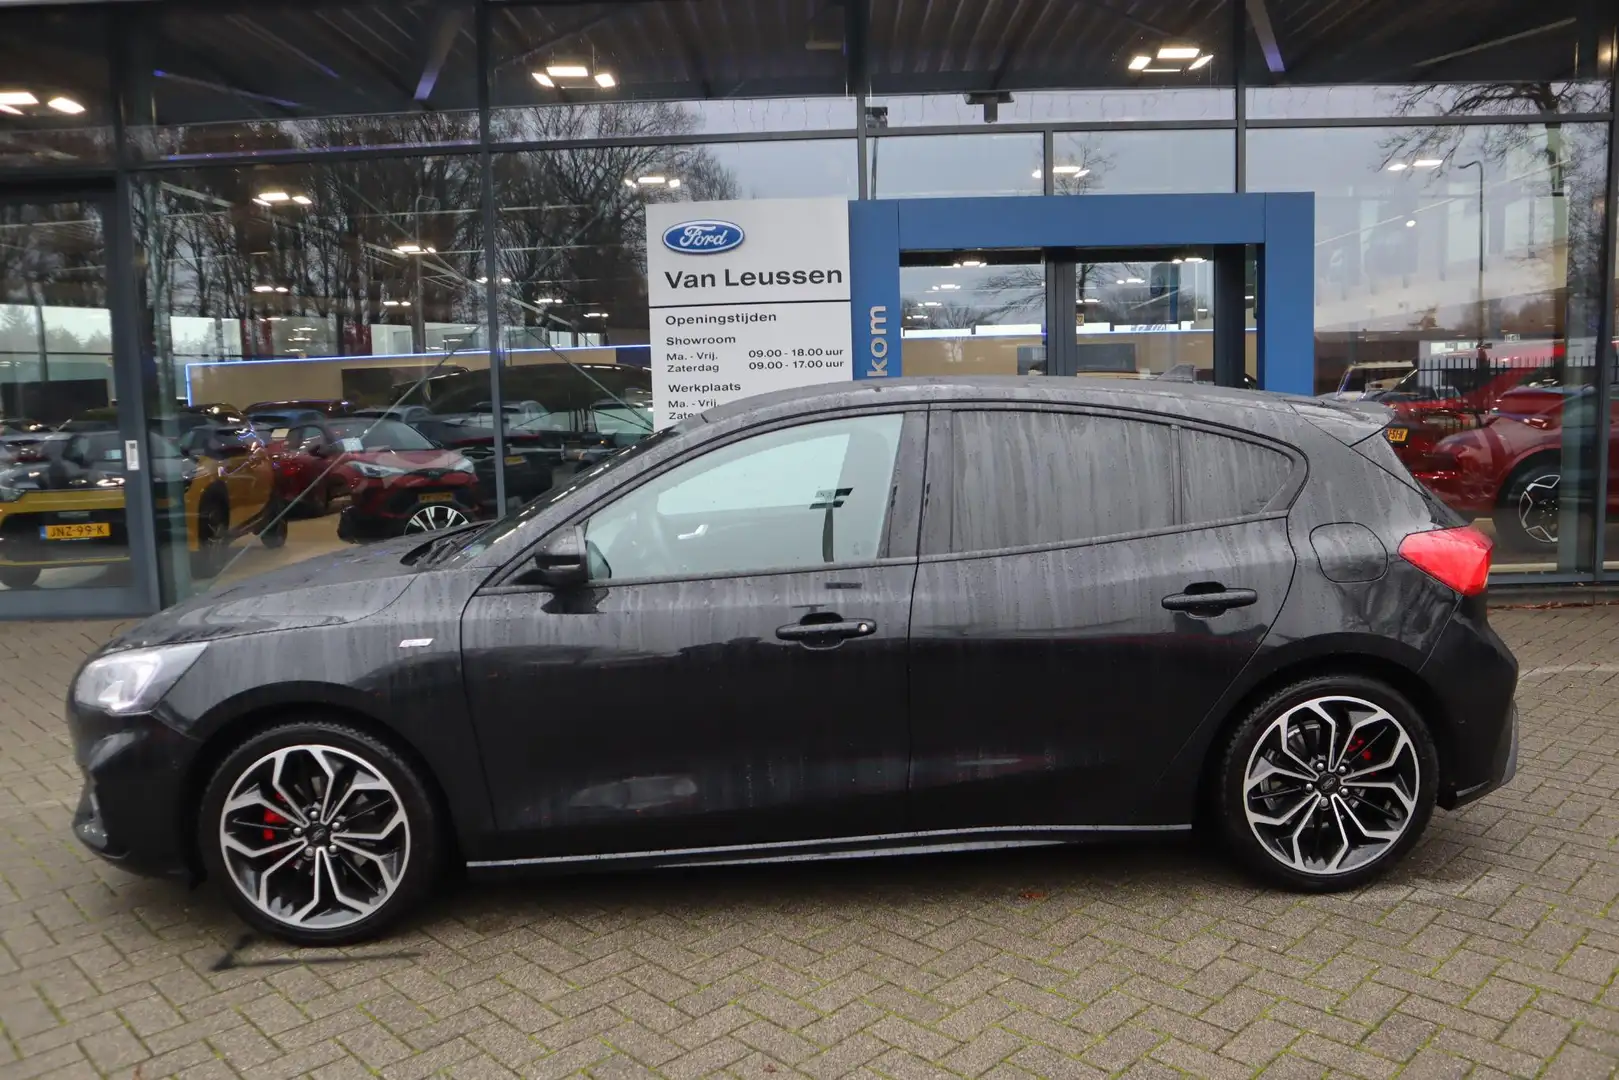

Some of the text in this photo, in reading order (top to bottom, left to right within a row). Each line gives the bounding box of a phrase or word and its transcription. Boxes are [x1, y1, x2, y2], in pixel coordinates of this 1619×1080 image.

[679, 225, 728, 247] Ford
[664, 268, 843, 289] Van Leussen
[665, 312, 777, 327] Openingstijden
[666, 336, 736, 346] Showroom
[666, 353, 688, 361] Ma.
[696, 352, 718, 361] Vrij.
[748, 349, 782, 358] 09.00
[791, 348, 823, 357] 18.00
[825, 348, 844, 356] uur
[667, 364, 720, 373] Zaterdag
[748, 361, 783, 370] 09.00
[793, 360, 823, 369] 17.00
[825, 360, 844, 368] uur
[668, 382, 741, 394] Werkplaats
[668, 400, 689, 408] Ma.
[50, 524, 105, 538] JNZ-99-K
